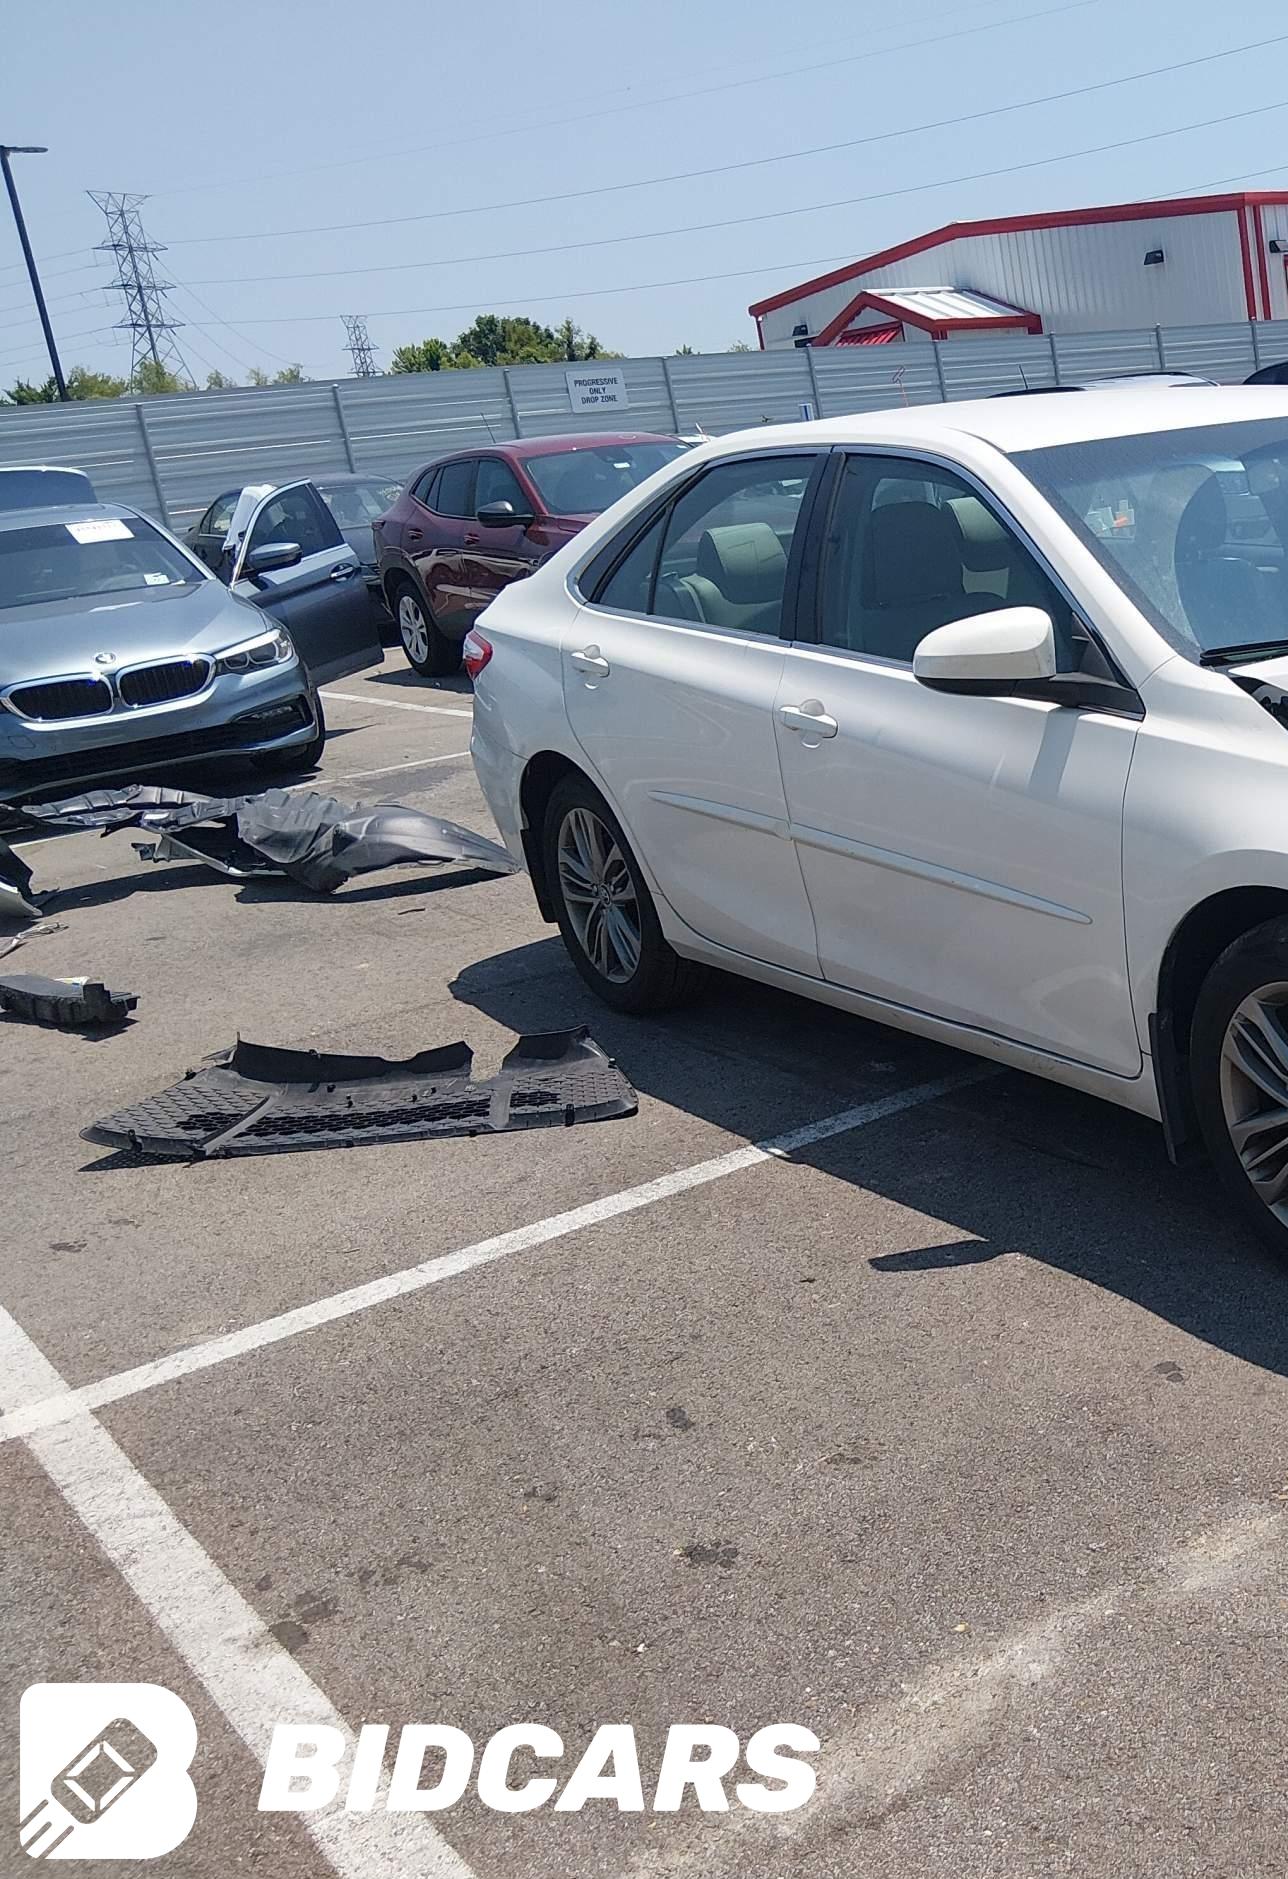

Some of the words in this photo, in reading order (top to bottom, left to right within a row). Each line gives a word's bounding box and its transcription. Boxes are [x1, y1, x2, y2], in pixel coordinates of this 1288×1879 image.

[574, 377, 618, 387] PROGRESSIVE
[589, 387, 606, 395] ONLY
[581, 396, 599, 404] DROP
[600, 394, 618, 403] ZONE
